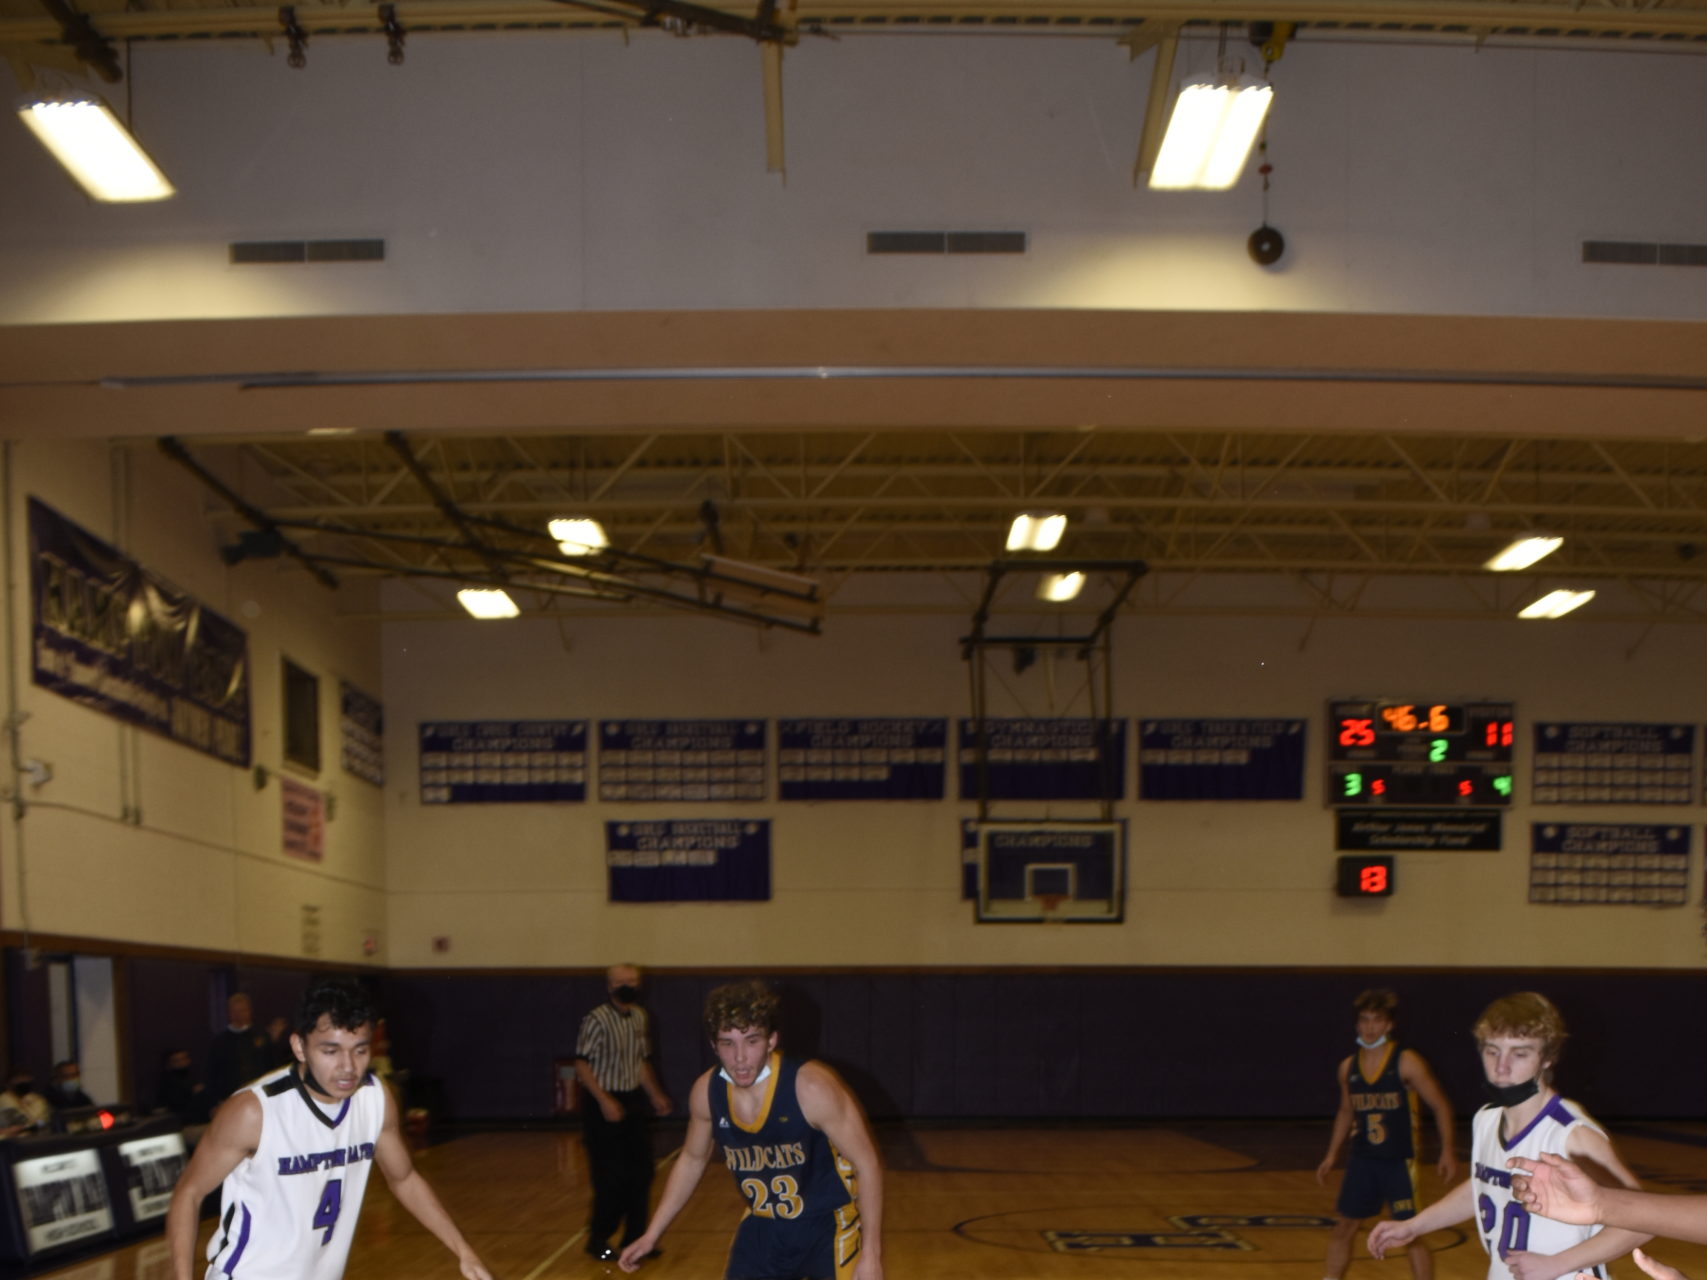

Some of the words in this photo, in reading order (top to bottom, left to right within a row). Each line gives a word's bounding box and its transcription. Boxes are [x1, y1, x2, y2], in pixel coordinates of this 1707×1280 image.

[1339, 719, 1376, 746] 25
[1486, 722, 1513, 746] 11
[452, 736, 555, 750] CHAMPIONS
[630, 736, 733, 749] CHAMPIONS
[810, 734, 914, 749] CHAMPIONS
[990, 734, 1095, 748] CHAMPIONS
[1170, 735, 1274, 749] CHAMPIONS
[1564, 739, 1664, 753] CHAMPIONS
[1429, 739, 1448, 762] 2
[1344, 773, 1362, 796] 3
[636, 835, 741, 850] CHAMPIONS
[993, 834, 1095, 848] CHAMPIONS
[1560, 839, 1660, 853] CHAMPIONS
[1366, 1112, 1388, 1145] 5
[723, 1142, 806, 1172] WILDCATS
[740, 1174, 804, 1219] 23
[312, 1179, 342, 1247] 4
